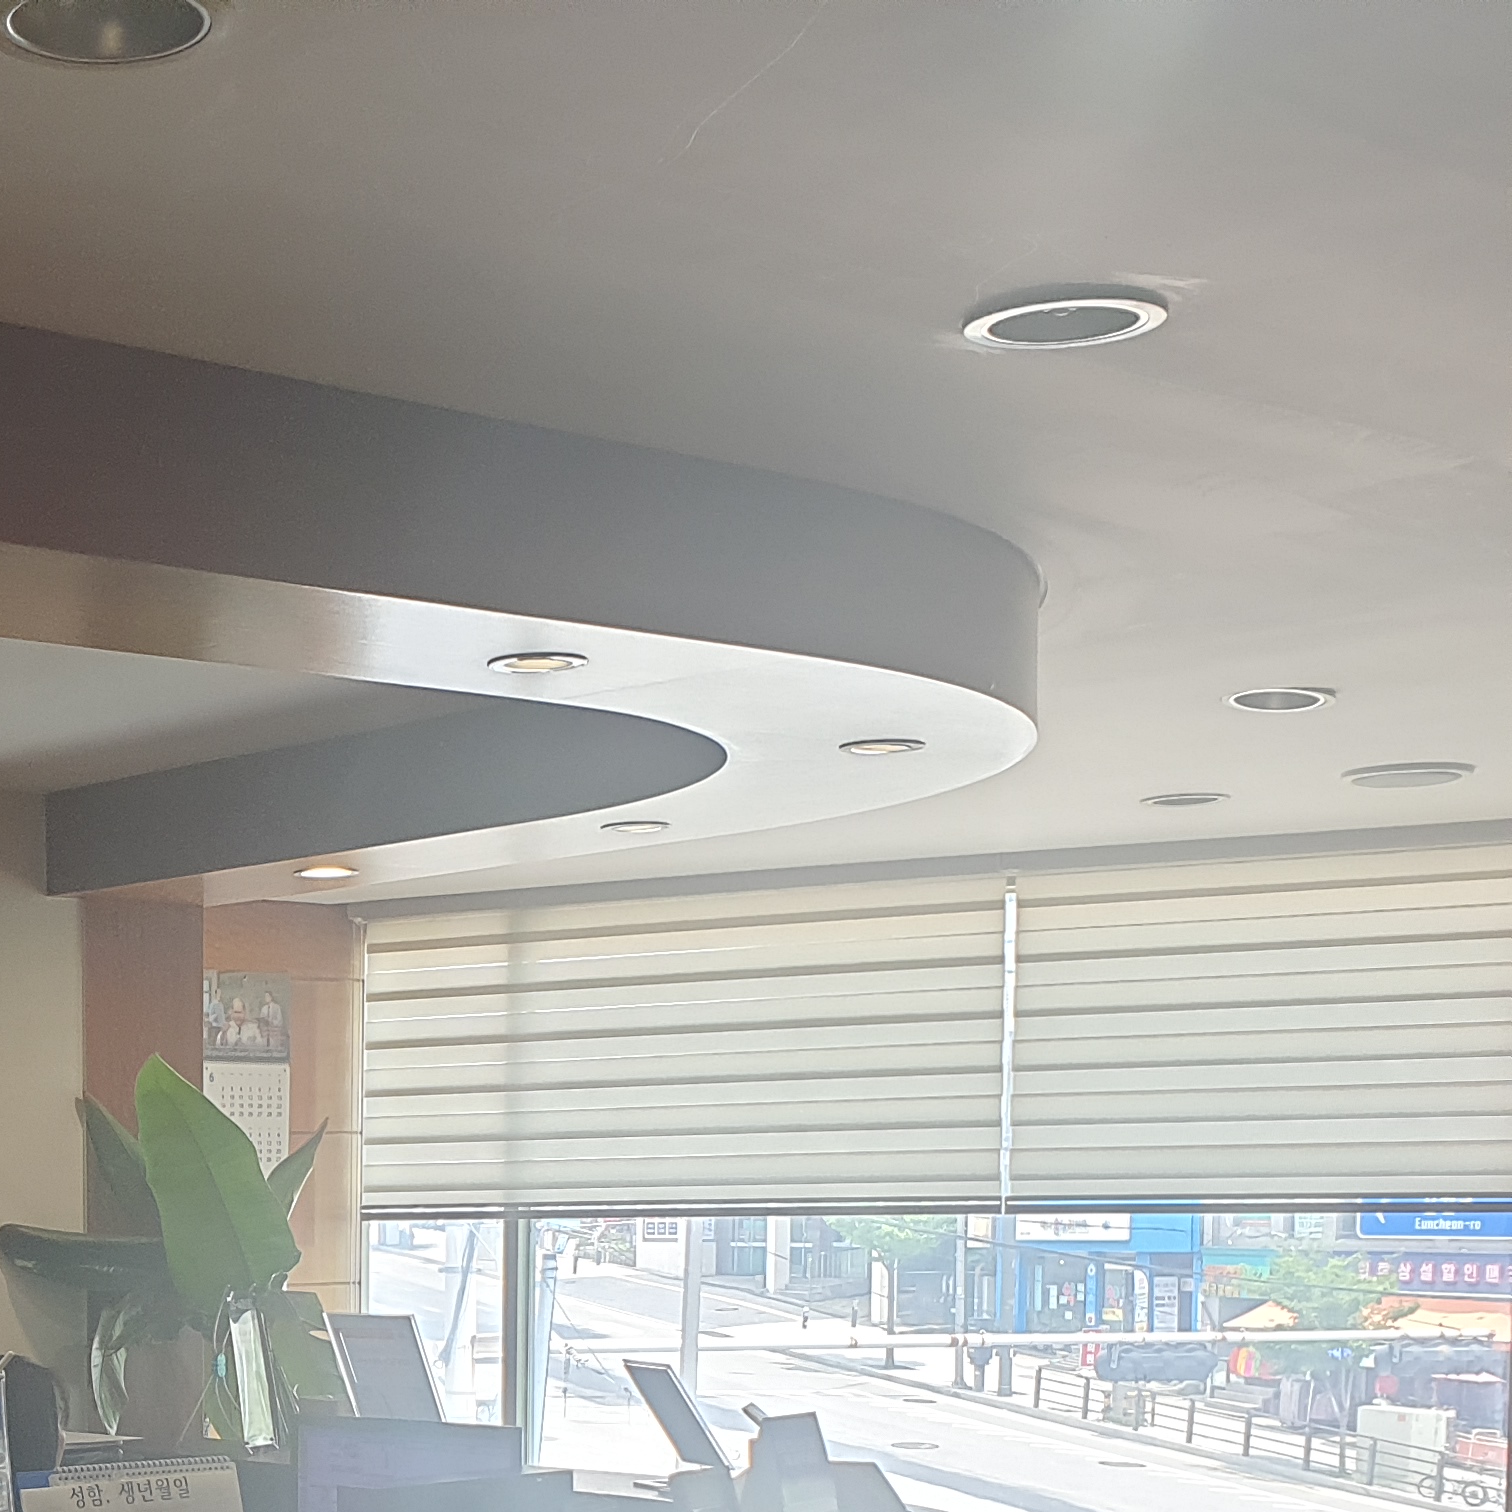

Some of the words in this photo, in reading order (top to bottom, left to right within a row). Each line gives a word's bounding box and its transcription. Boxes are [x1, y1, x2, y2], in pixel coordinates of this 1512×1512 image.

[1414, 1217, 1482, 1231] Euncheon-ro
[69, 1484, 111, 1509] 성함.
[118, 1476, 190, 1503] 생년월일
